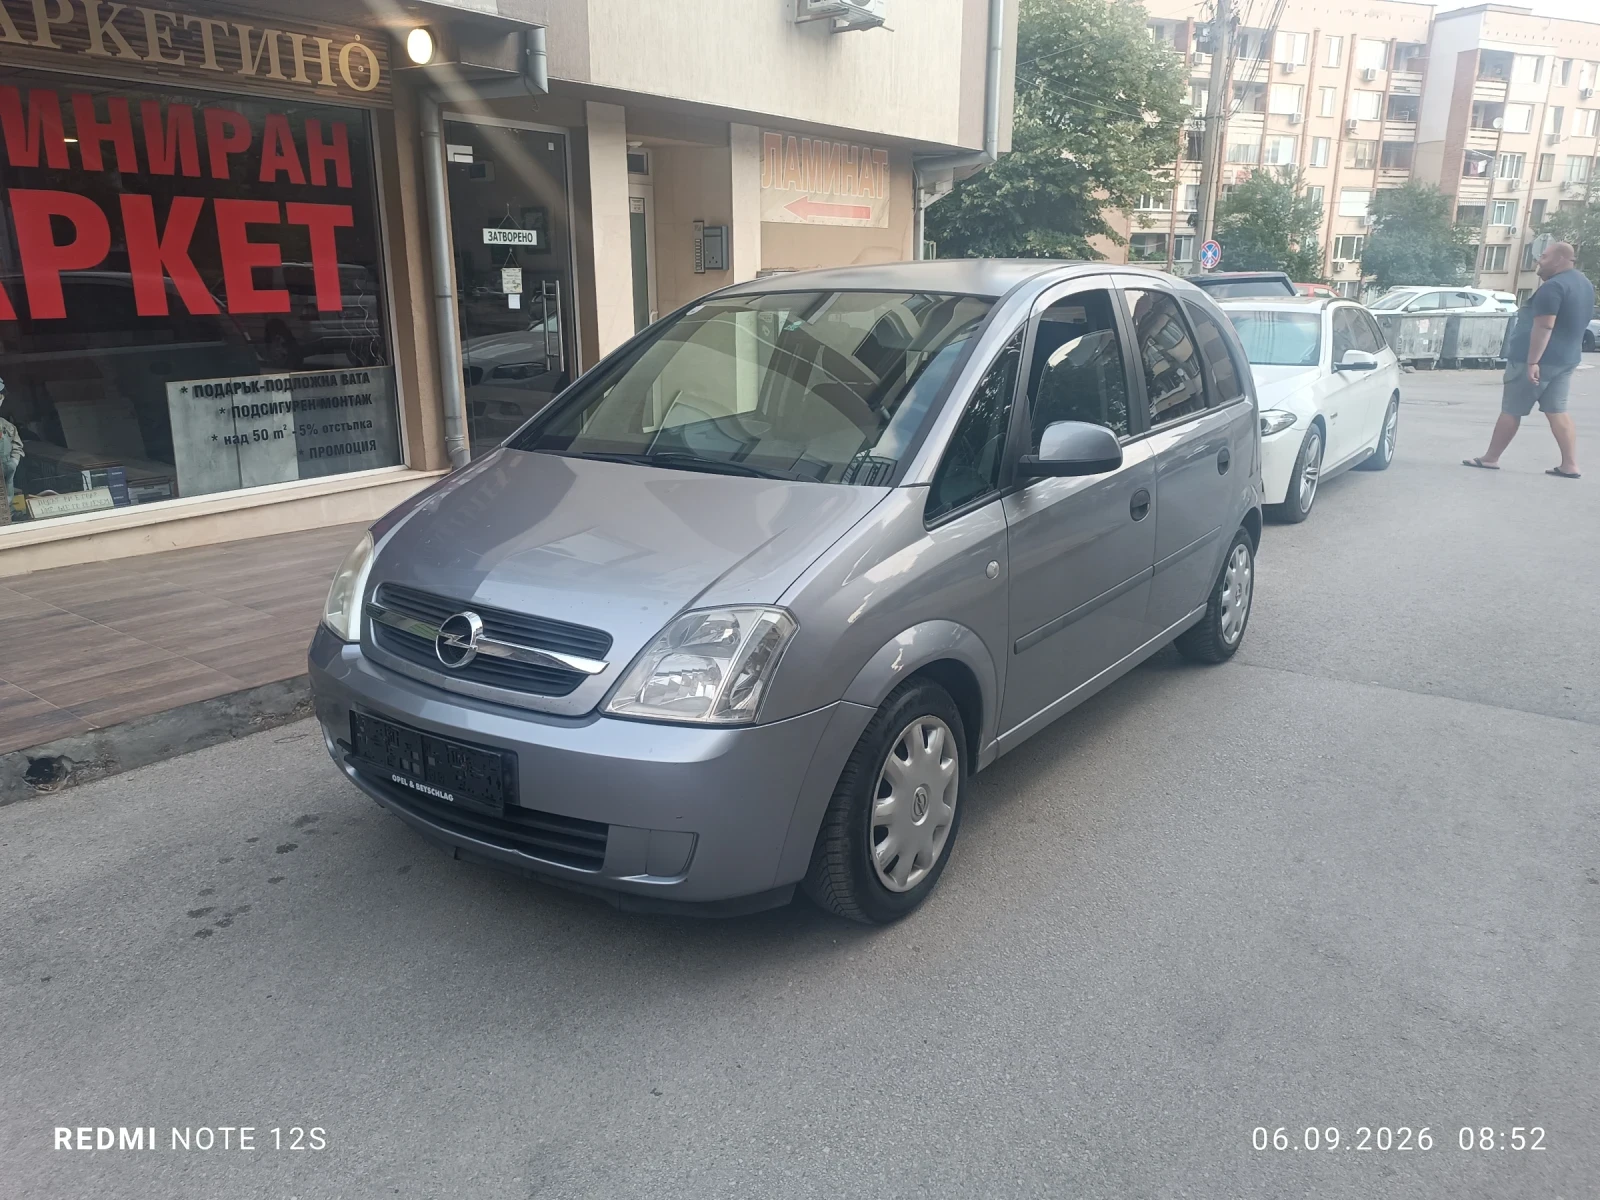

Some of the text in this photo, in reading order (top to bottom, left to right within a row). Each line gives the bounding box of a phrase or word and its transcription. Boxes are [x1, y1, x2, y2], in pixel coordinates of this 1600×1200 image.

[0, 85, 353, 188] ИНИРАН
[762, 131, 888, 199] ЛАМИНАТ
[488, 230, 533, 243] ЗАТВОРЕНО
[0, 188, 354, 320] РКЕТ
[193, 371, 371, 398] ПОДАРЪК-ПОДЛОЖНА ВАТА
[230, 393, 373, 419] ПОДСИГУРЕН МОНТАЖ
[223, 433, 250, 446] над
[252, 428, 269, 442] 50
[299, 423, 319, 436] 5%
[322, 419, 373, 434] отстъпка
[309, 439, 377, 460] ПРОМОЦИЯ
[392, 774, 408, 787] OPEL
[415, 783, 453, 802] BEYSCHLAG
